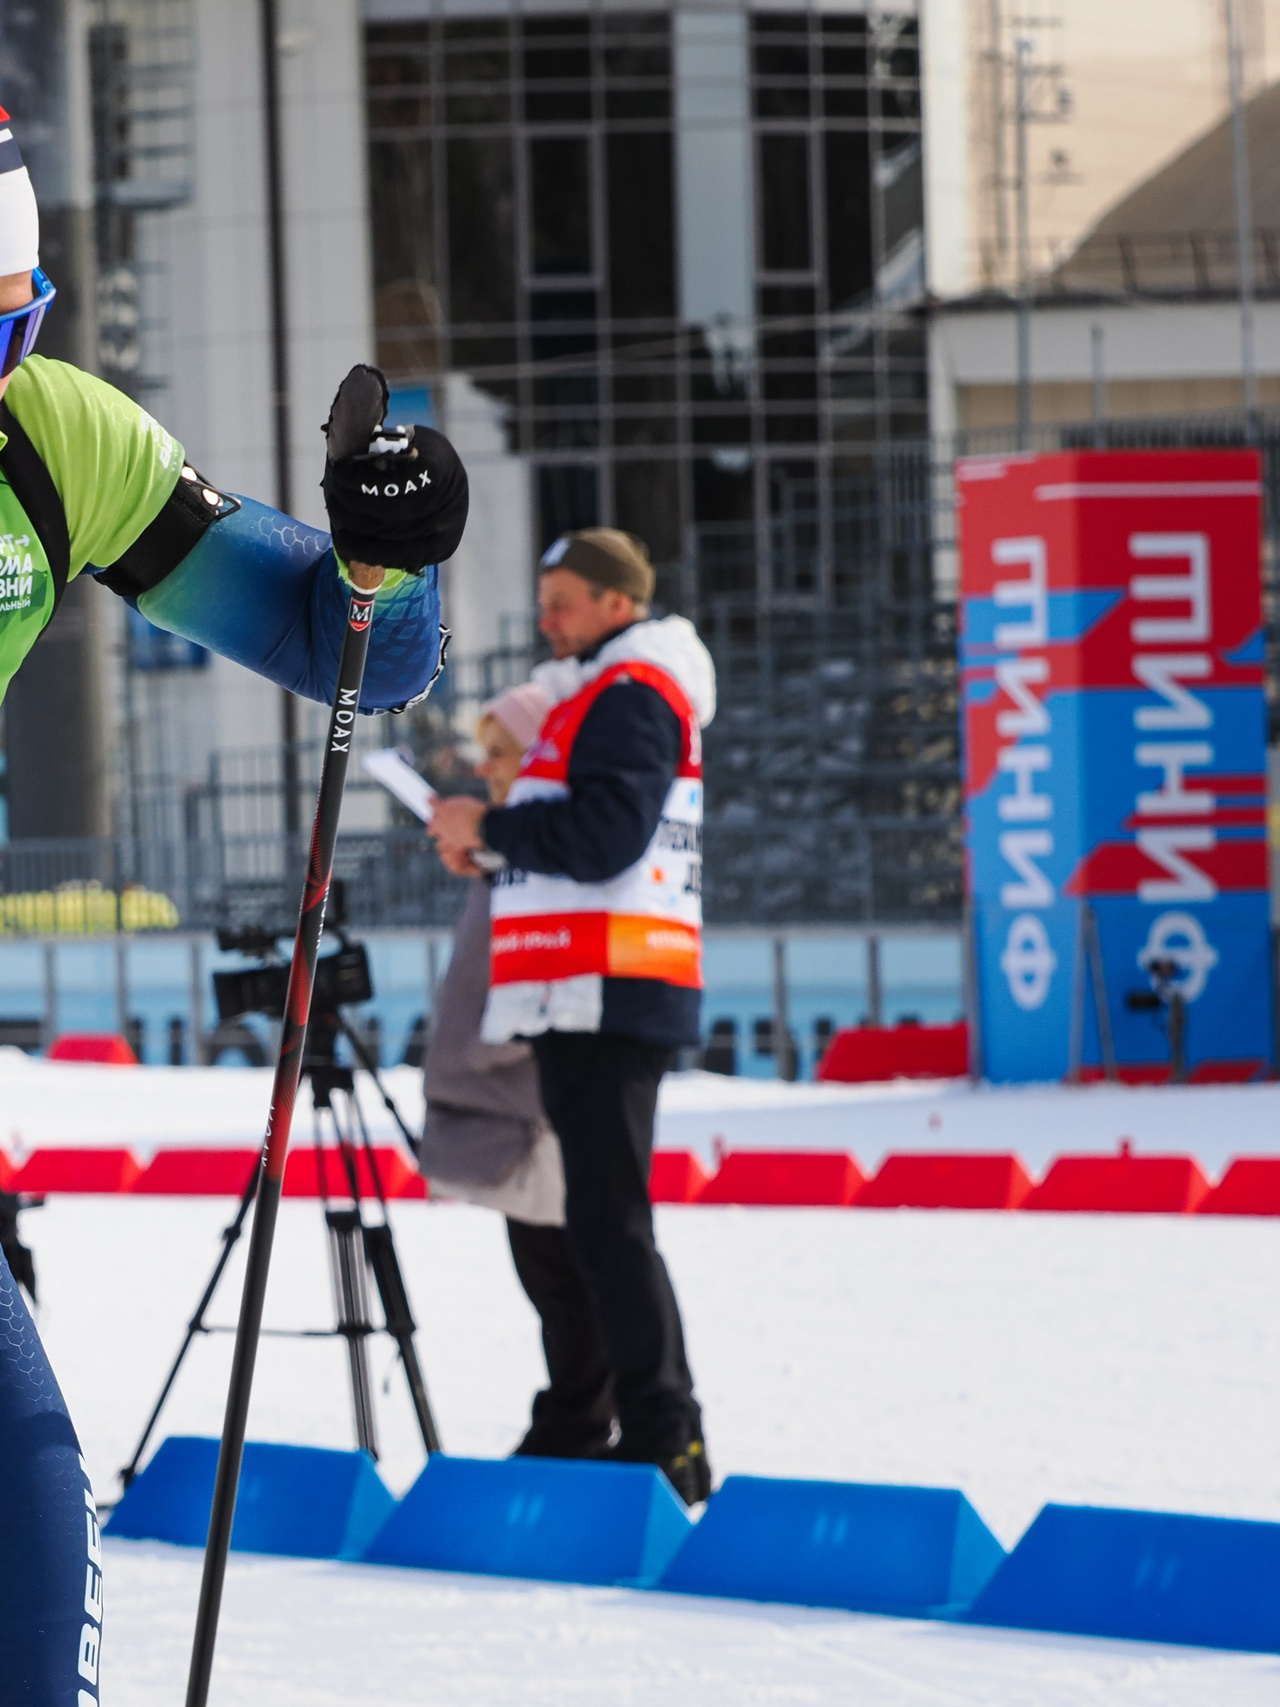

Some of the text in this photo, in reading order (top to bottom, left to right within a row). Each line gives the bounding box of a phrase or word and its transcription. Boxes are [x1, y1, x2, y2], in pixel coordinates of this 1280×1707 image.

[361, 469, 432, 497] MOAX
[330, 688, 358, 752] MOAX
[991, 536, 1057, 1011] ФИНИШ
[1128, 531, 1218, 1004] ФИНИШ
